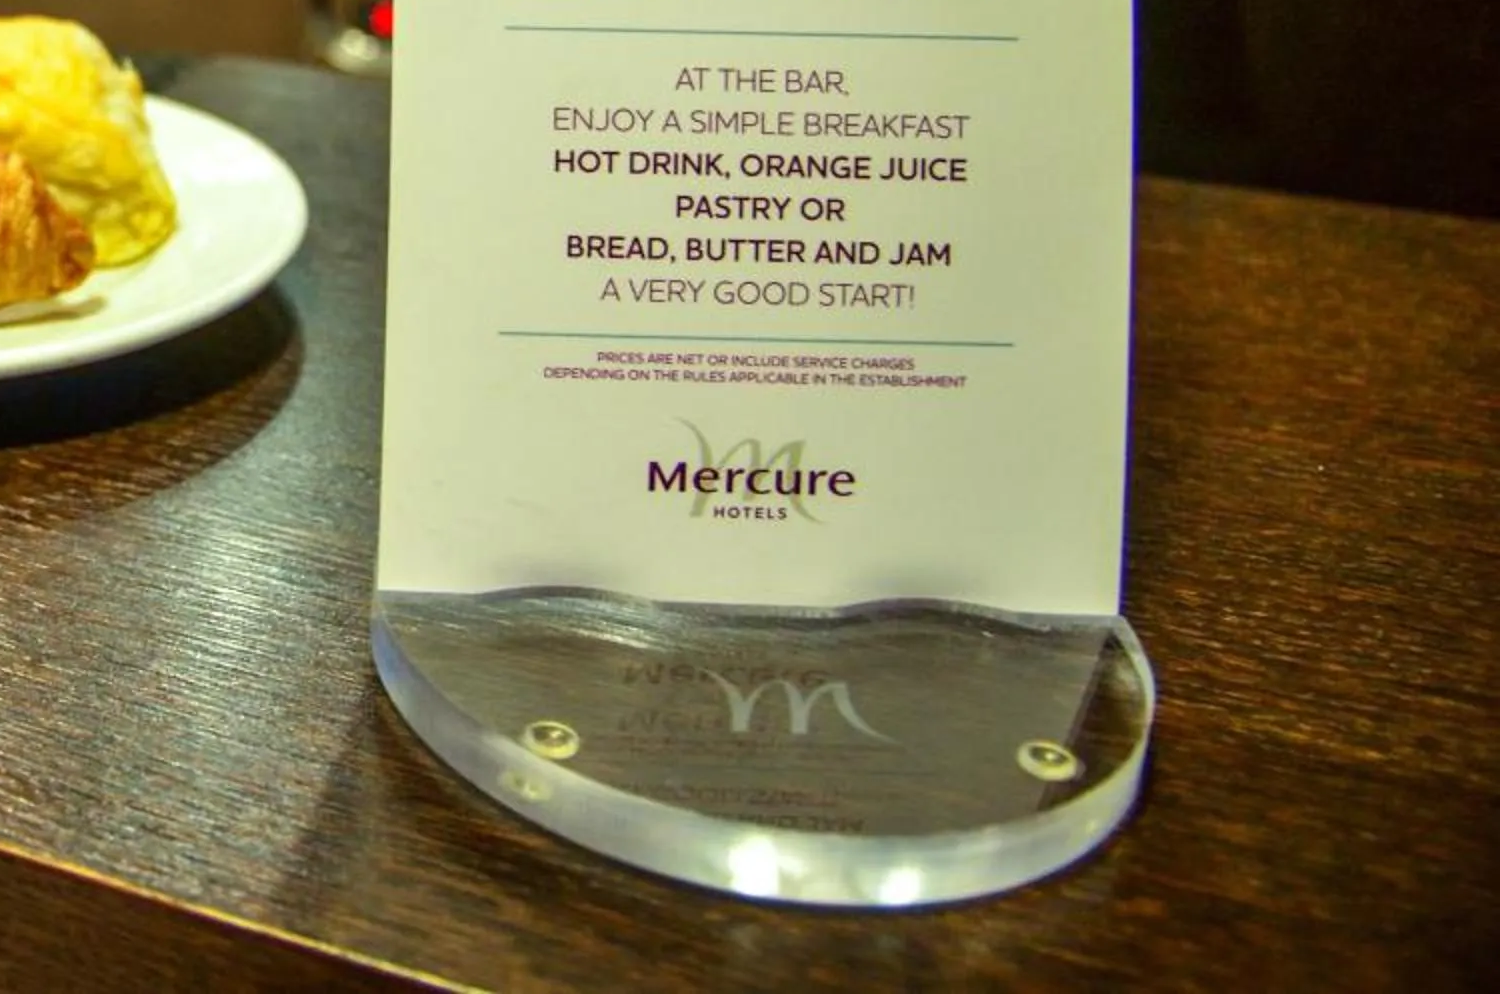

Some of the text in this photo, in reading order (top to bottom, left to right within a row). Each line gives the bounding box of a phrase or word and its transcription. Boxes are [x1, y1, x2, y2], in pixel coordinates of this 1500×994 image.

[674, 67, 850, 97] AT THE BAR,
[552, 106, 971, 140] ENJOY A SIMPLE BREAKFAST
[553, 149, 968, 183] HOT DRINK, ORANGE JUICE
[675, 194, 845, 223] PASTRY OR
[566, 234, 952, 268] BREAD, BUTTER AND JAM
[599, 277, 915, 308] A VERY GOOD START!
[597, 351, 916, 371] PRICES ARE NET OR INCLUDE SERVICE CHARGES
[543, 366, 968, 388] DEPENDING ON THE RULES APPLICABLE IN THE ESTABLISHMENT
[647, 461, 856, 498] Mercure
[712, 505, 788, 520] HOTELS
